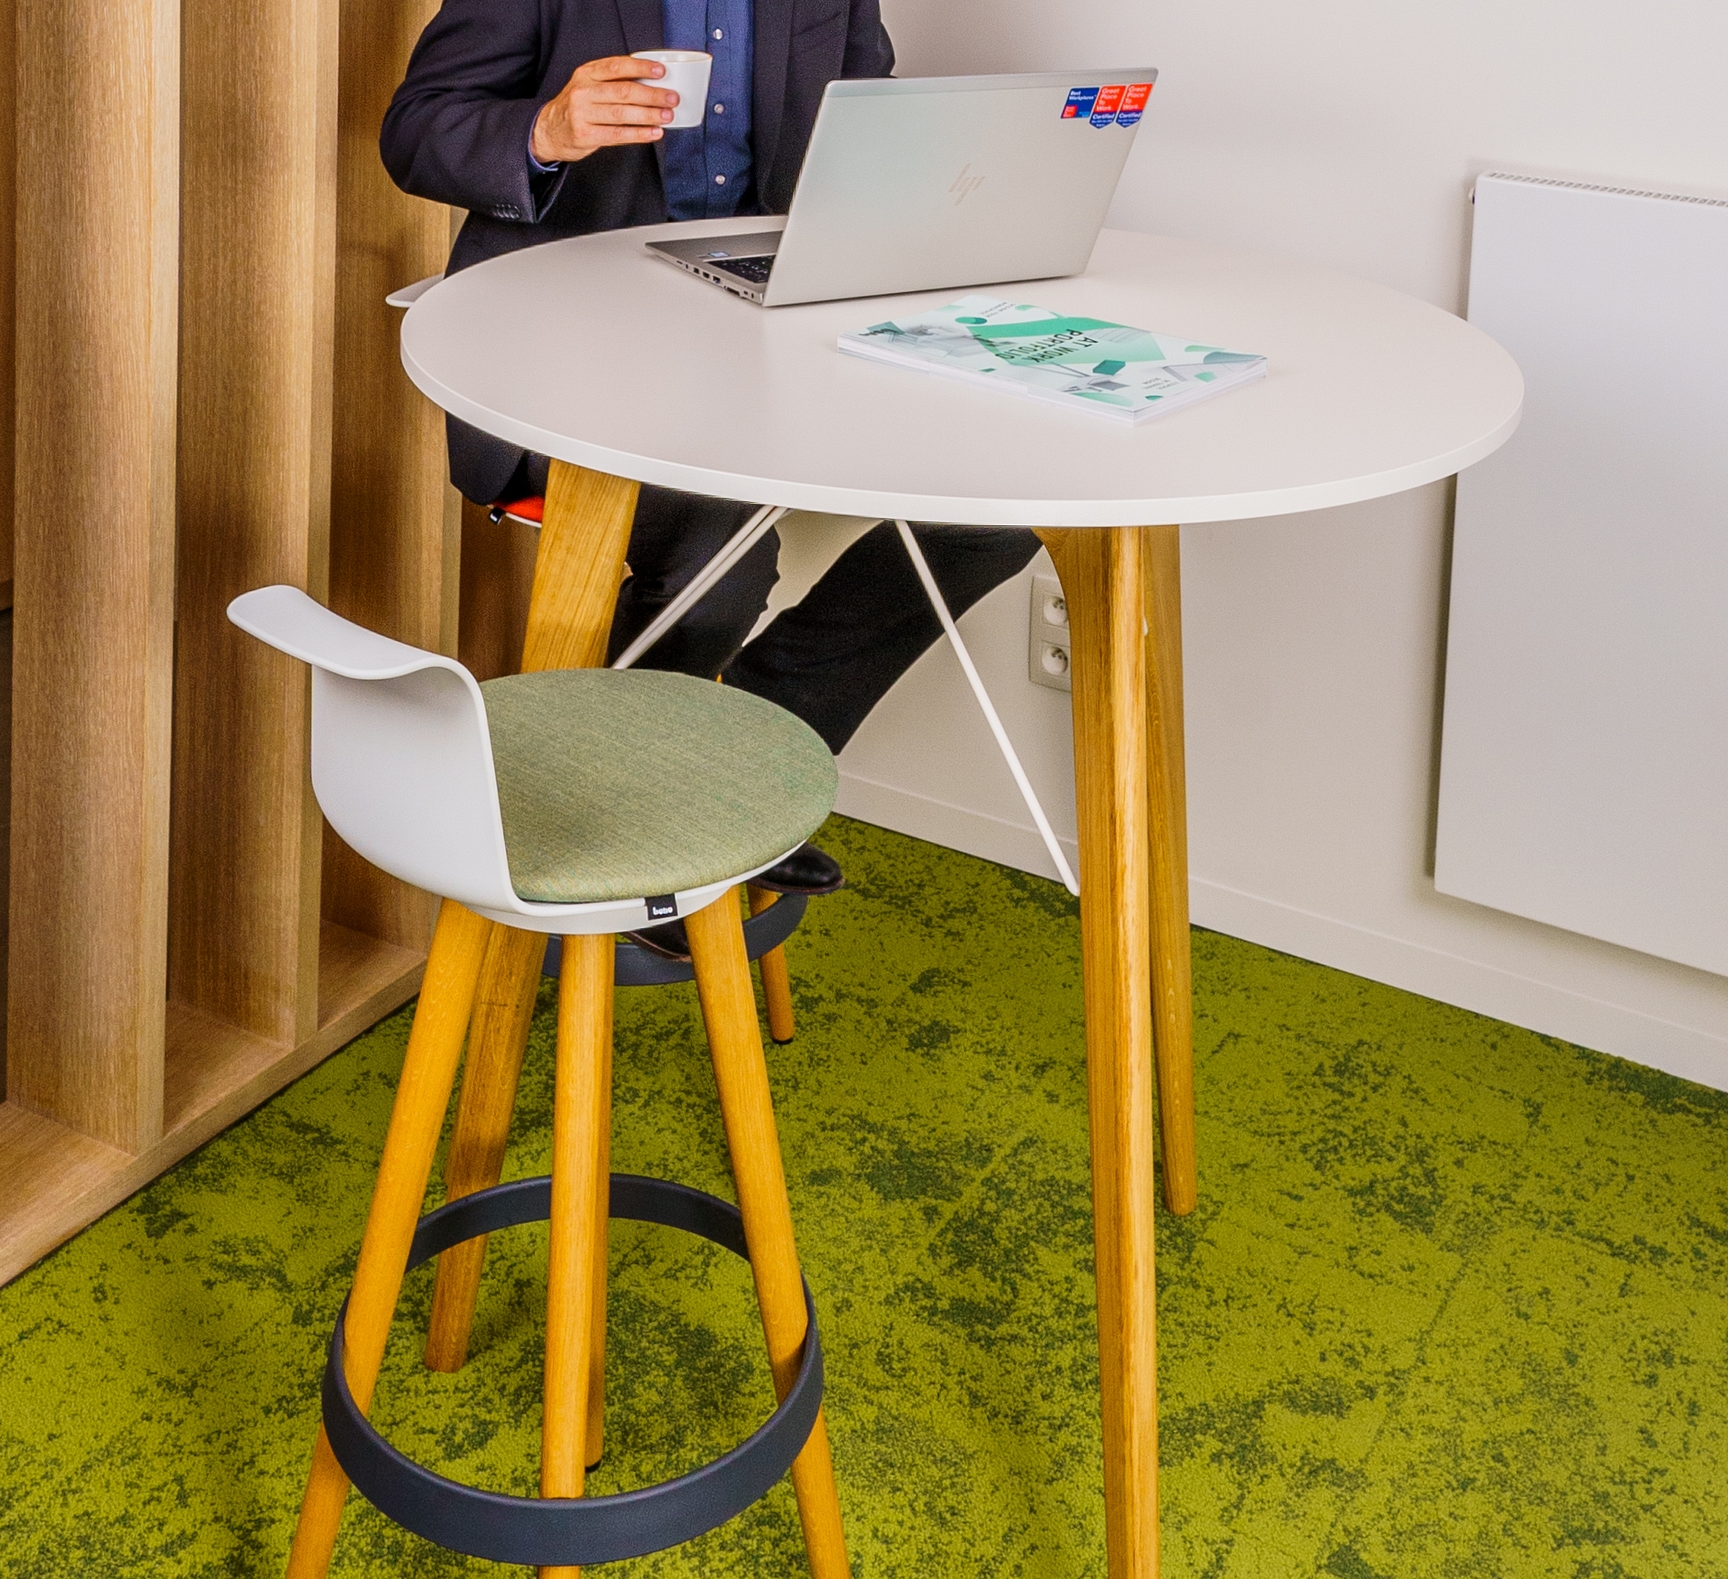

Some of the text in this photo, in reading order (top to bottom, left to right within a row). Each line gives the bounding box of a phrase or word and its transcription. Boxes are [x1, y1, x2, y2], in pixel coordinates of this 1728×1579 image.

[994, 328, 1084, 360] PORTFOLIO
[1021, 336, 1099, 363] AT WORK
